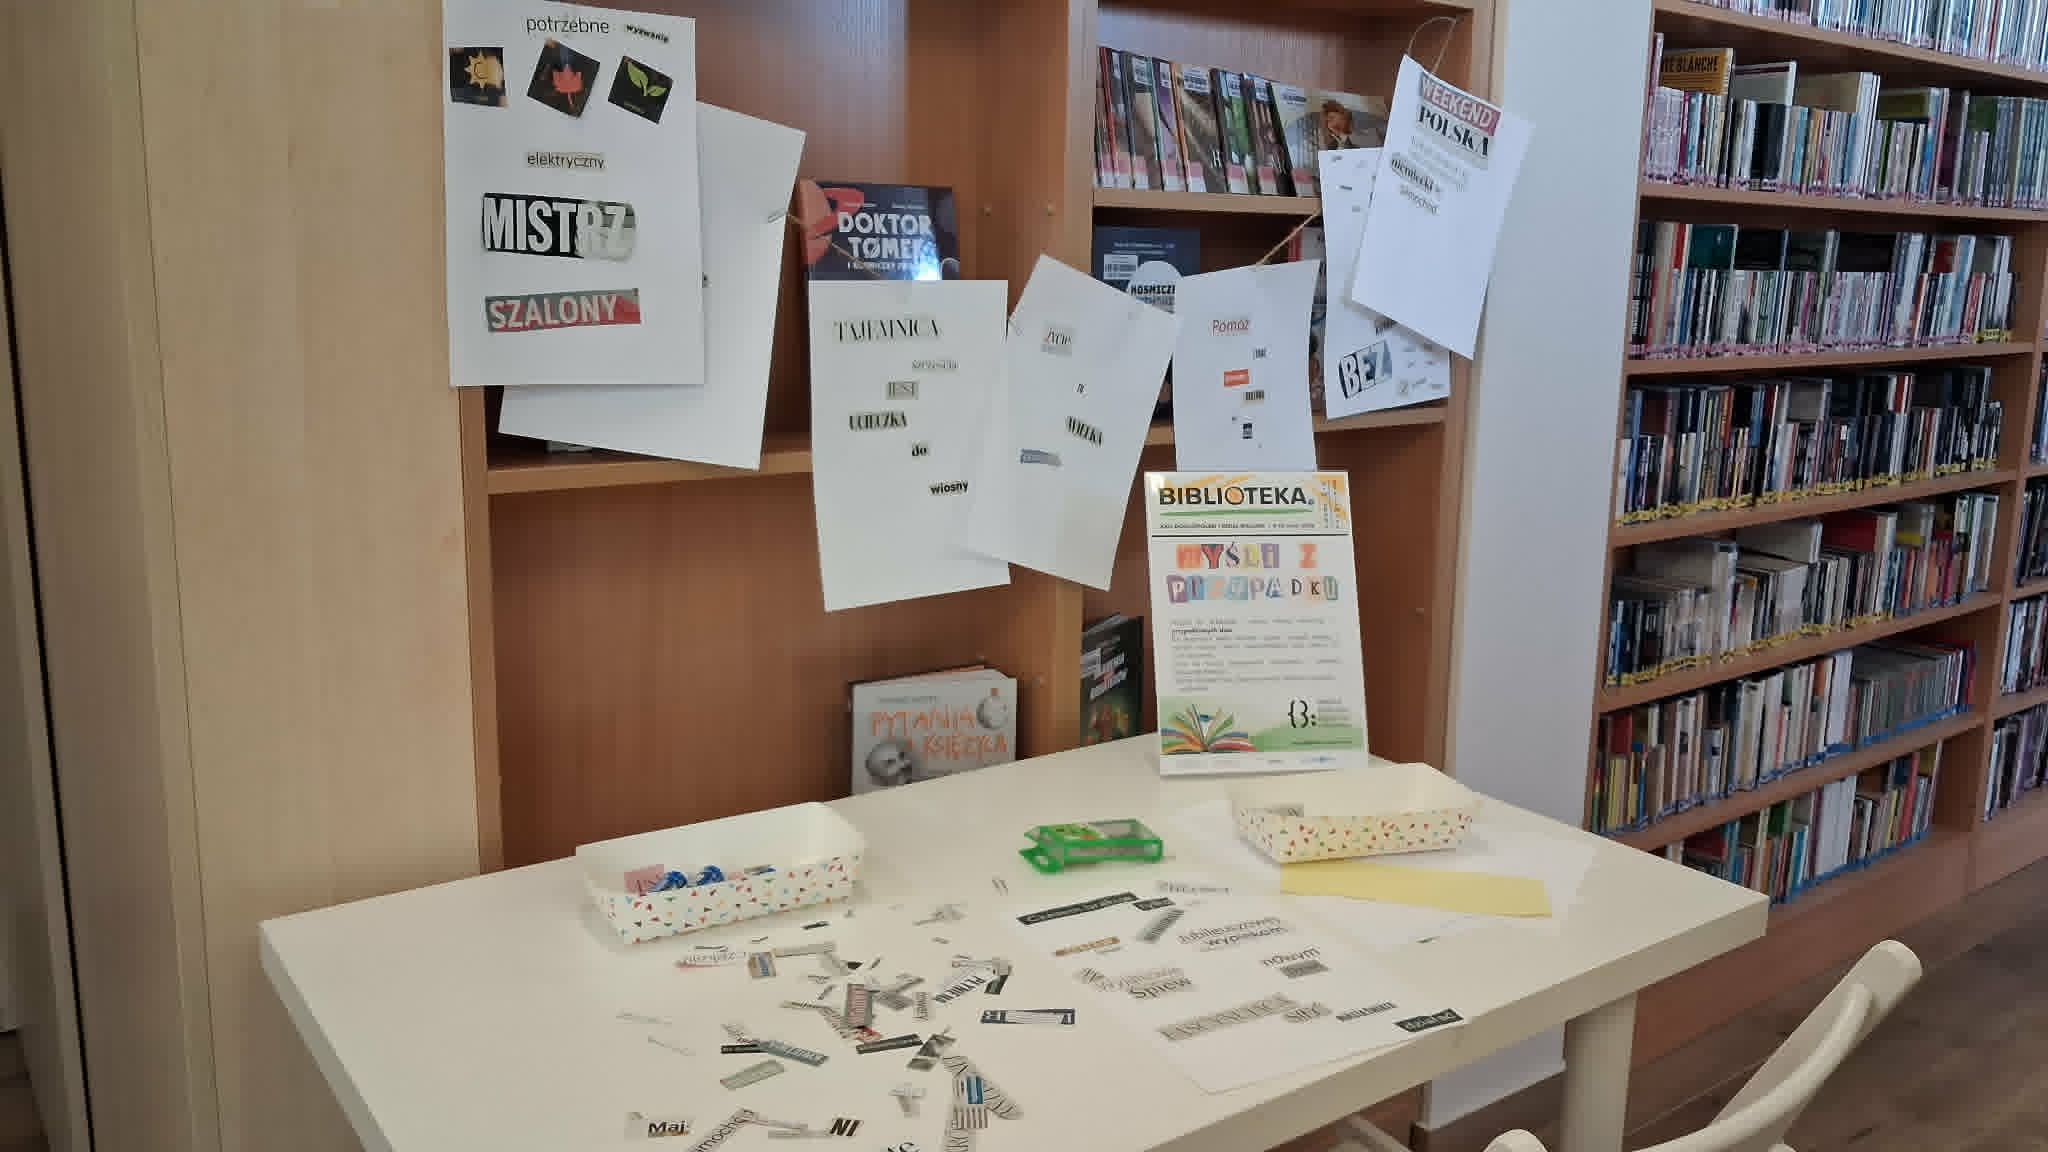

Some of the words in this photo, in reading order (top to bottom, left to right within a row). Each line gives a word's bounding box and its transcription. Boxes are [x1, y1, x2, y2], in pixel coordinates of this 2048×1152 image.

[526, 16, 610, 34] potrzebne
[1419, 74, 1495, 130] WEEKEND
[1417, 105, 1490, 158] POLSKA
[526, 152, 605, 169] elektryczny
[484, 195, 634, 258] MISTRZ
[838, 211, 935, 236] DOKTOR
[488, 294, 619, 328] SZALONY
[930, 480, 969, 495] wiosny
